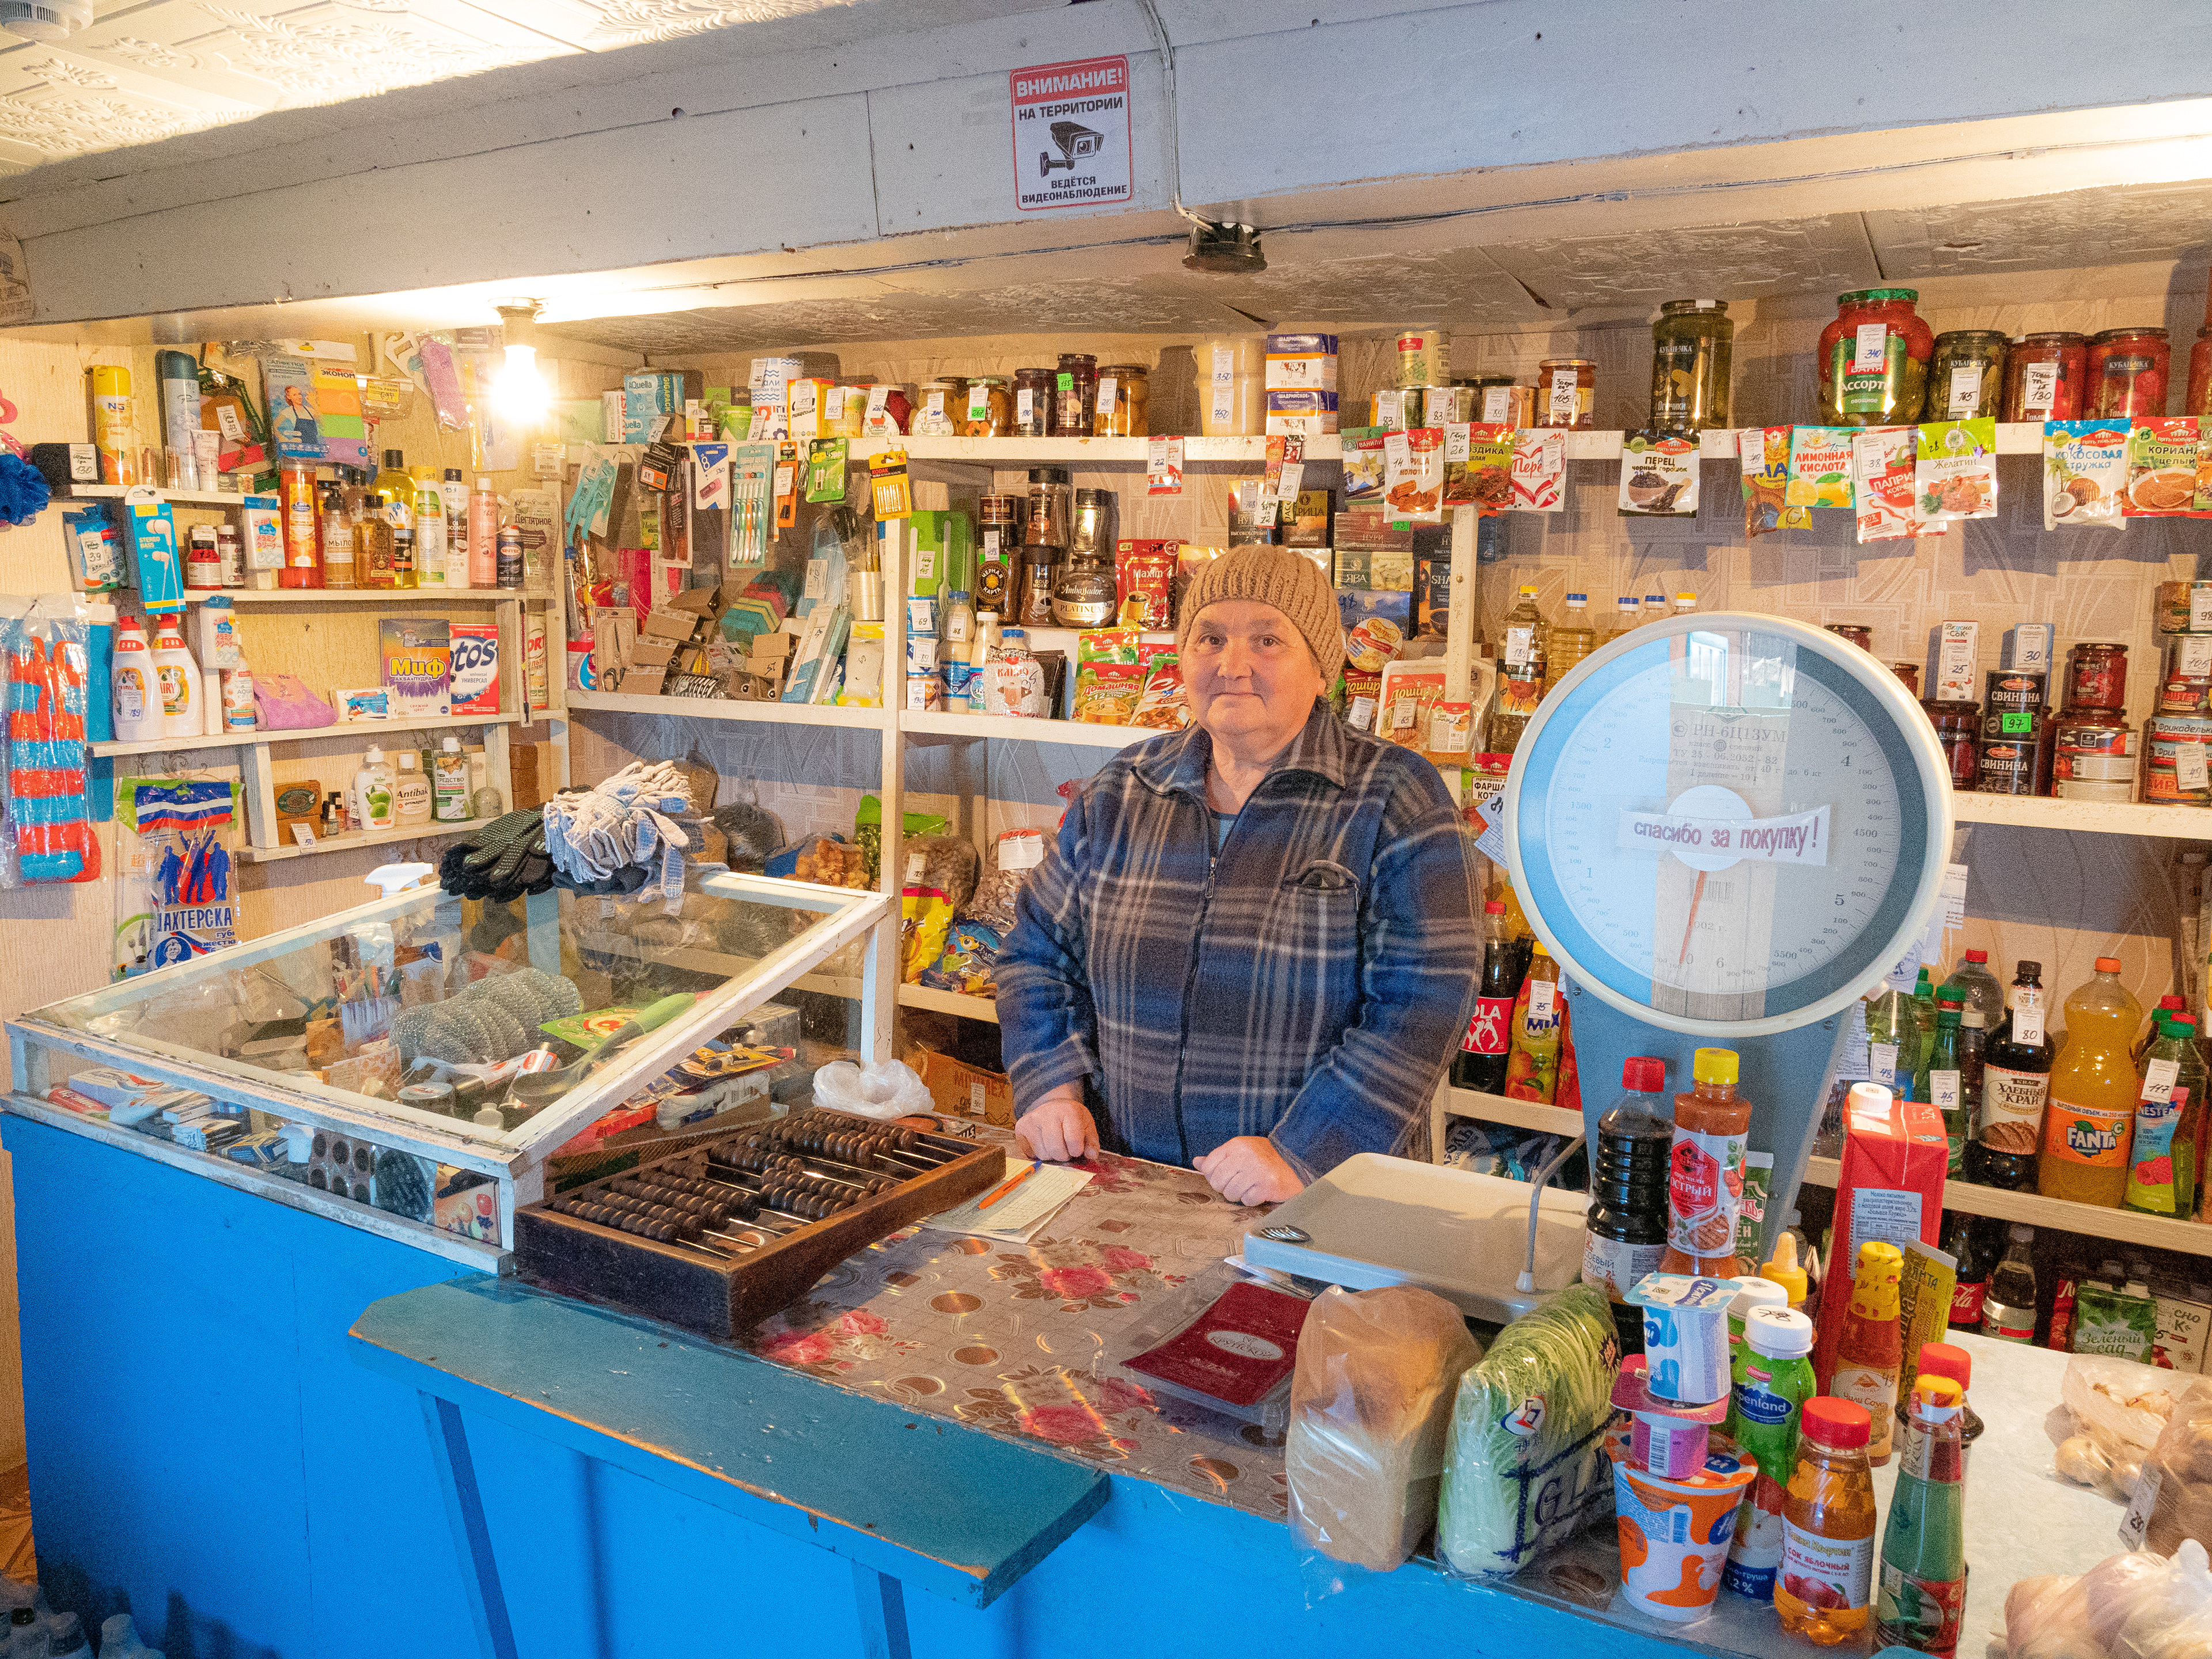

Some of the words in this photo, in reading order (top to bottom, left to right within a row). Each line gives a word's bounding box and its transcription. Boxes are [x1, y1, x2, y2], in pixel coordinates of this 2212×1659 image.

[1017, 68, 1122, 97] ВНИМАНИЕ!
[1020, 109, 1035, 120] НА
[1040, 96, 1123, 118] ТЕРРИТОРИИ
[1051, 176, 1096, 188] ВЕДЁТСЯ
[1022, 185, 1127, 203] ВИДЕОНАБЛЮДЕНИЕ
[321, 369, 355, 379] ЭКОНОМ
[1795, 451, 1853, 463] ЛИМОННАЯ
[2055, 450, 2122, 460] КОКОСОВАЯ
[1645, 457, 1676, 467] ПЕРЕЦ
[1800, 462, 1847, 472] КИСЛОТА
[1933, 459, 1976, 469] Желатин
[2064, 461, 2111, 471] стружка
[982, 568, 1003, 579] ЧЕРНАЯ
[1133, 569, 1164, 579] Maxim
[983, 587, 1001, 595] КАРТА
[1060, 604, 1105, 613] PLATINUM
[390, 657, 446, 678] Миф
[159, 682, 176, 695] AIRY
[1992, 691, 2040, 703] СВИНИНА
[1604, 737, 1611, 749] 2
[1841, 755, 1852, 766] 4
[1980, 759, 2028, 772] СВИНИНА
[397, 786, 429, 798] Antibak
[1634, 822, 1702, 845] спасибо
[1711, 829, 1730, 848] за
[1835, 894, 1844, 906] 5
[1716, 957, 1724, 968] 6
[1471, 1007, 1501, 1020] OLA
[1998, 1081, 2046, 1097] ХЛЕБНЫЙ
[2005, 1093, 2039, 1105] КРАЙ
[2067, 1128, 2117, 1154] FANTA
